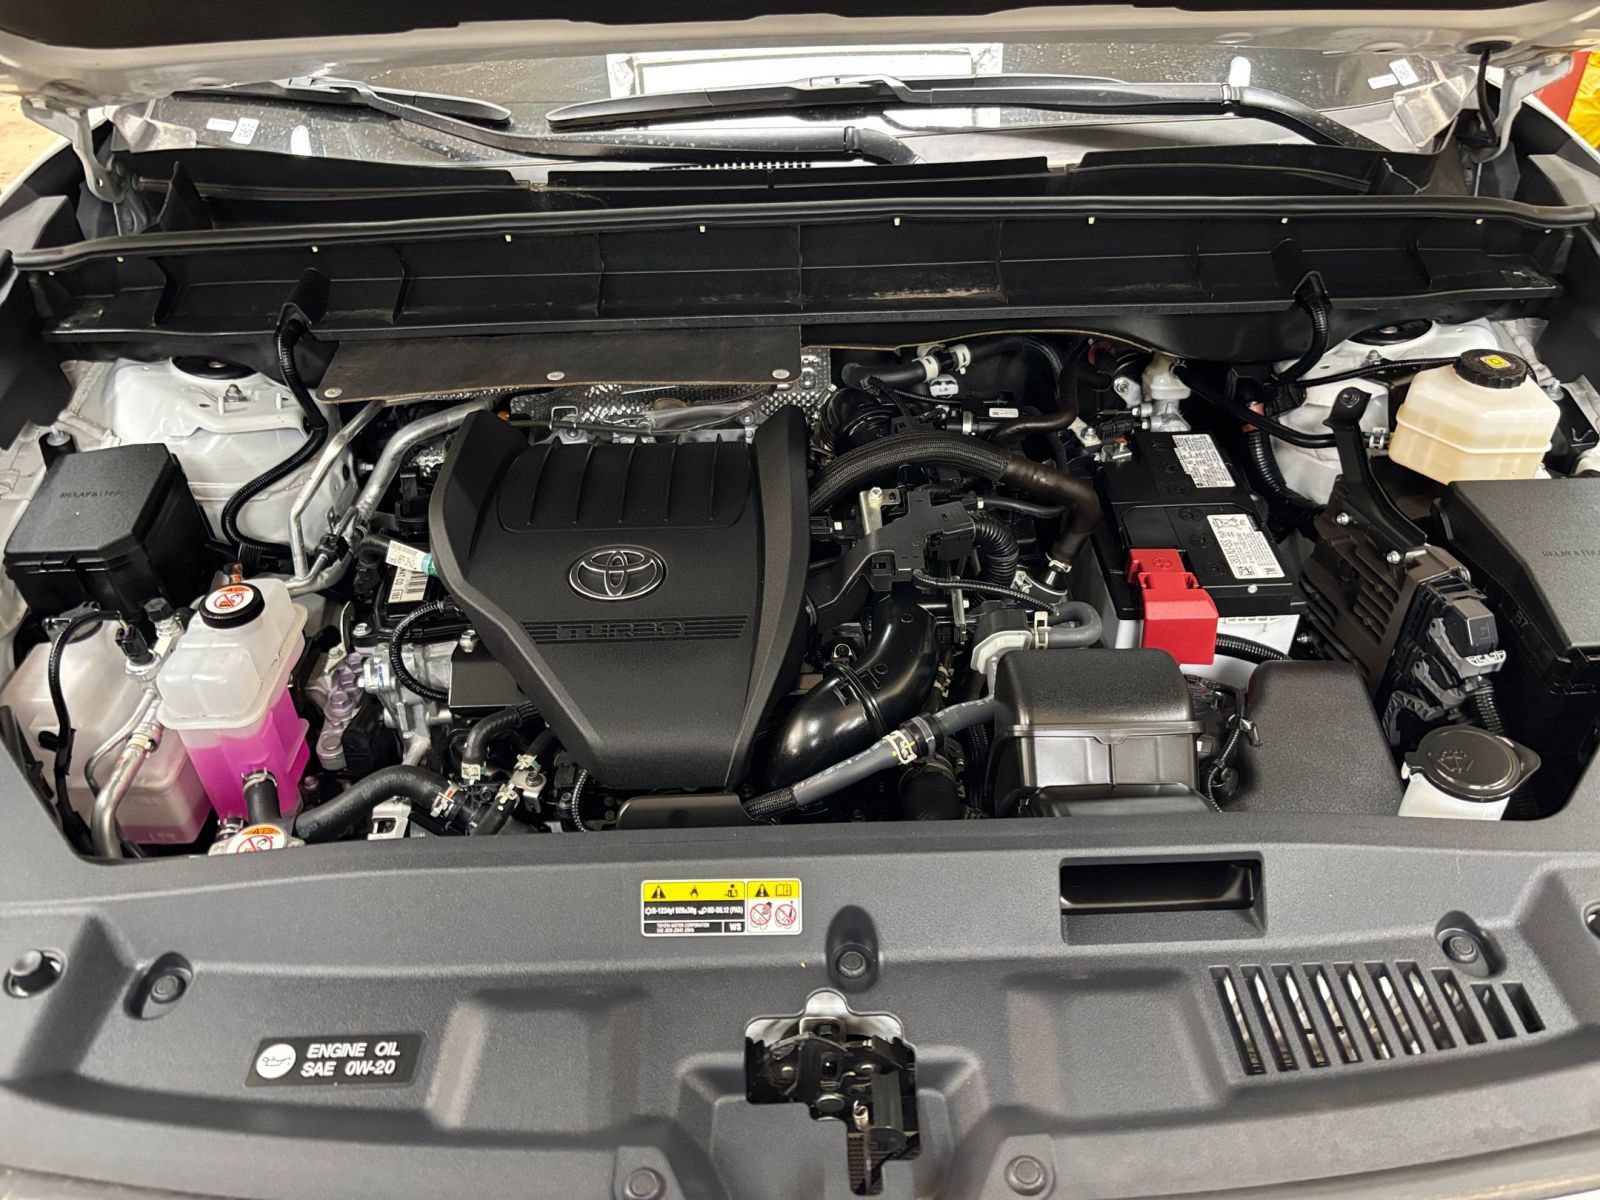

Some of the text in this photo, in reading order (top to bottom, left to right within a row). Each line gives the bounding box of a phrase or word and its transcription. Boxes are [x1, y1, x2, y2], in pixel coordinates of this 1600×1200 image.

[557, 621, 686, 640] TURBO
[729, 923, 742, 931] WS
[307, 1042, 401, 1058] ENGINE OIL
[300, 1060, 396, 1077] SAE 0W-20
